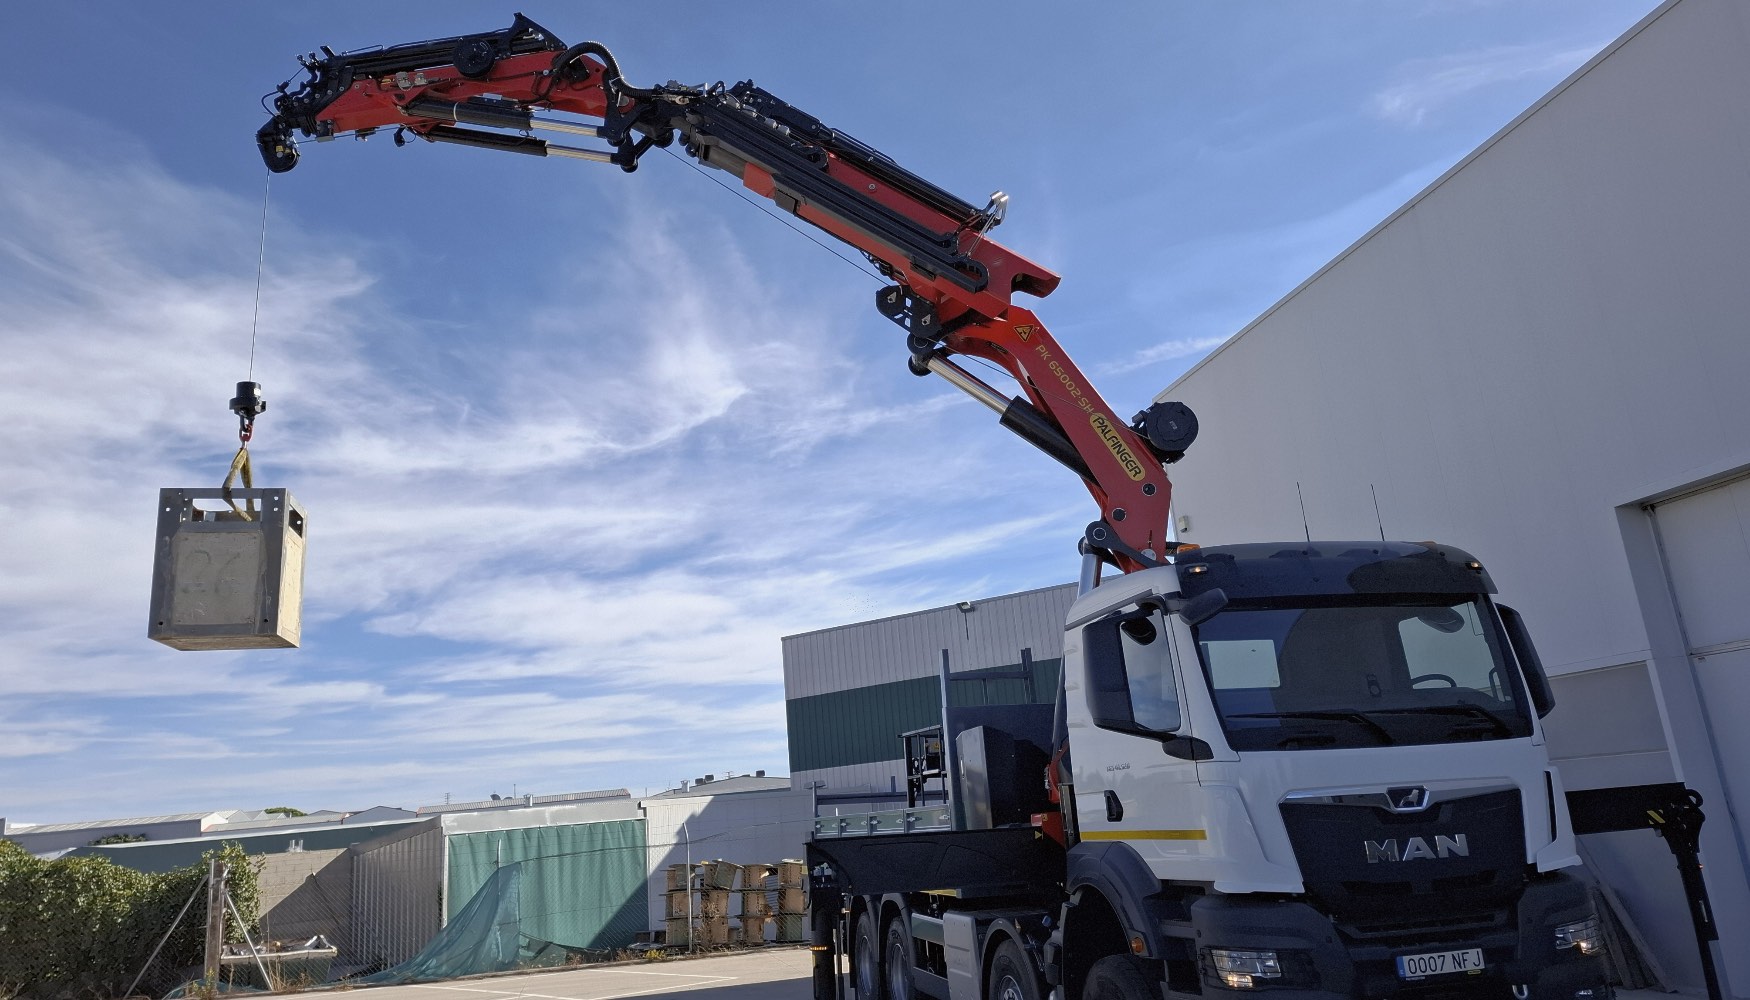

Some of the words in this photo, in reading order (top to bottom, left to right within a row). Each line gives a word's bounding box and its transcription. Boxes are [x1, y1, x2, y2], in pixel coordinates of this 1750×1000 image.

[1035, 344, 1052, 361] PK
[1092, 415, 1142, 478] PALFINGER
[1363, 833, 1470, 864] MAN
[1407, 954, 1446, 975] 0007
